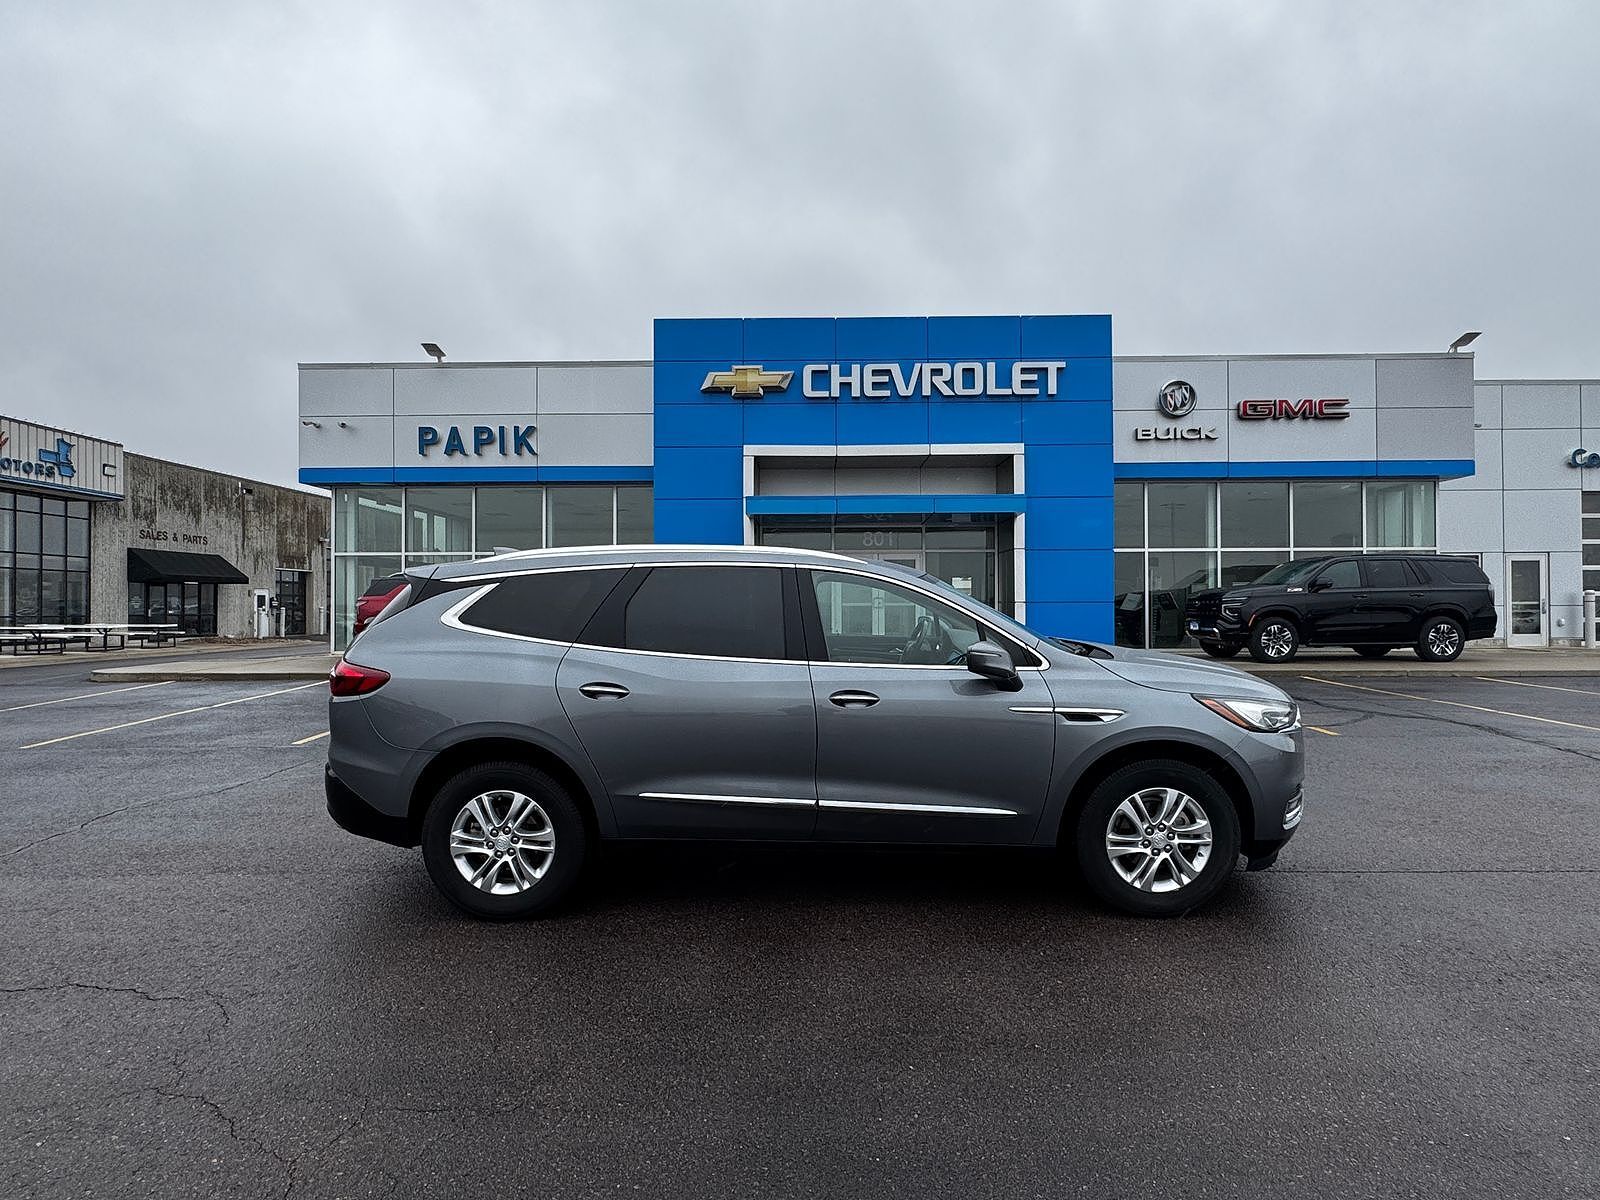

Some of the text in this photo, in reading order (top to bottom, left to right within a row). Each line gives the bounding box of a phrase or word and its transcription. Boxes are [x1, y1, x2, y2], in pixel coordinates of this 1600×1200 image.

[802, 361, 1067, 398] CHEVROLET
[1238, 398, 1350, 420] GMC
[418, 425, 538, 456] PAPIK
[1136, 427, 1218, 441] BUICK
[139, 528, 208, 546] SALES & PARTS
[862, 531, 894, 547] 801
